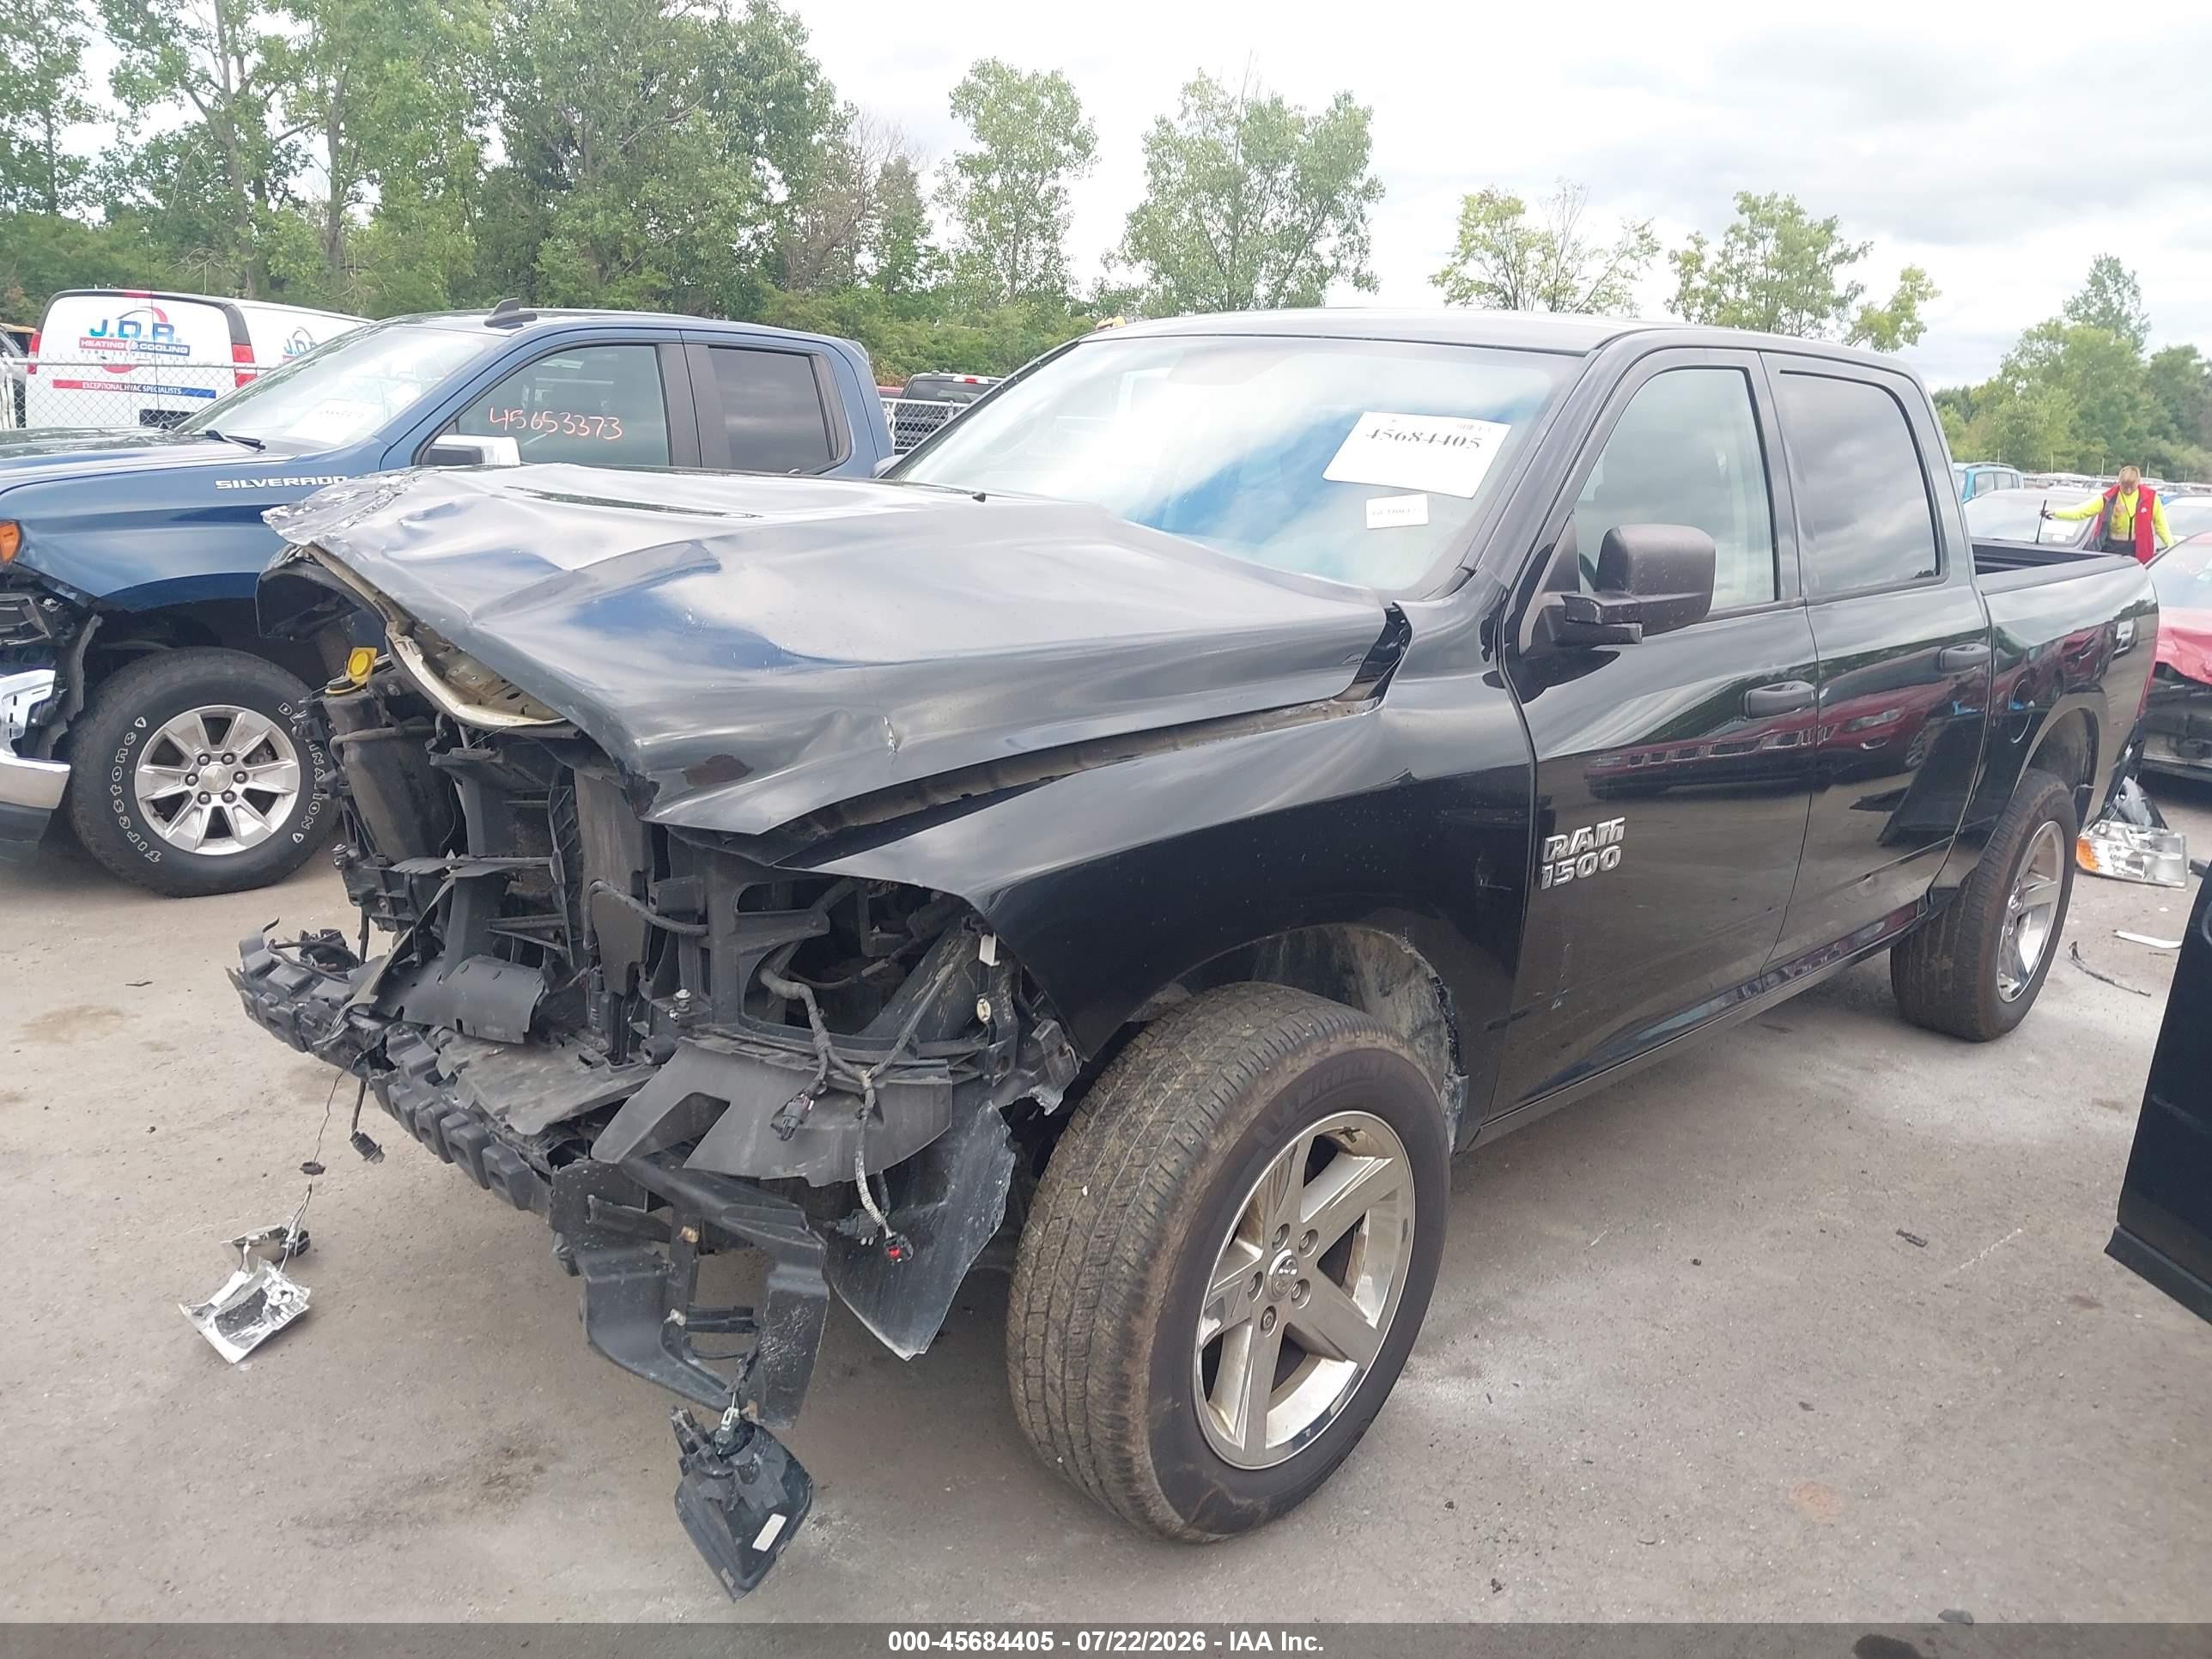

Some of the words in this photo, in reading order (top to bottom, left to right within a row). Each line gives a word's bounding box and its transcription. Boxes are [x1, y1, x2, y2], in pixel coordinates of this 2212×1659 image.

[81, 339, 125, 349] HEATING
[139, 343, 189, 354] COOLING
[82, 381, 124, 391] EXCEPTIONAL
[124, 384, 142, 392] HVAC
[143, 385, 182, 395] SPECIALISTS
[489, 407, 623, 441] 45653373
[1365, 428, 1483, 449] 45684405
[1542, 817, 1626, 863] RAM
[1540, 844, 1622, 890] 1500
